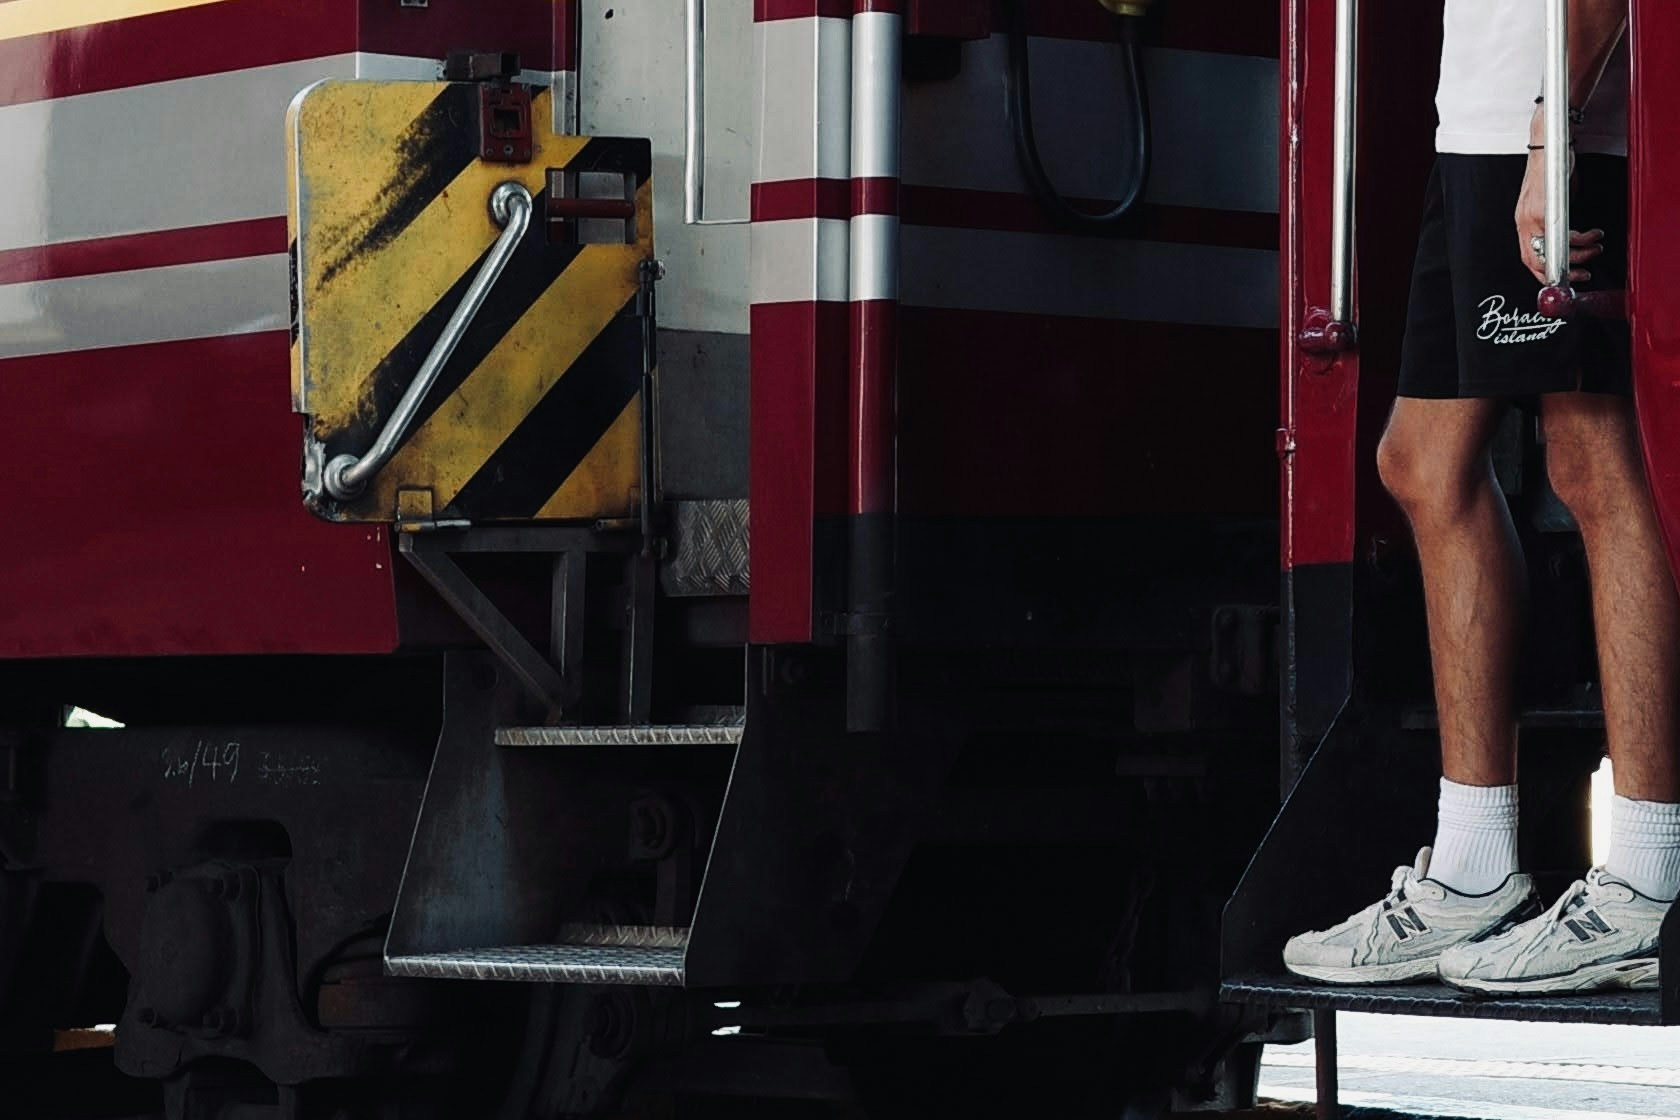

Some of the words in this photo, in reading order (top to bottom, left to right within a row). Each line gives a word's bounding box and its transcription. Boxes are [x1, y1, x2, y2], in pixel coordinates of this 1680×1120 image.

[1493, 326, 1551, 345] island
[1386, 903, 1433, 943] N
[1563, 904, 1618, 945] N
